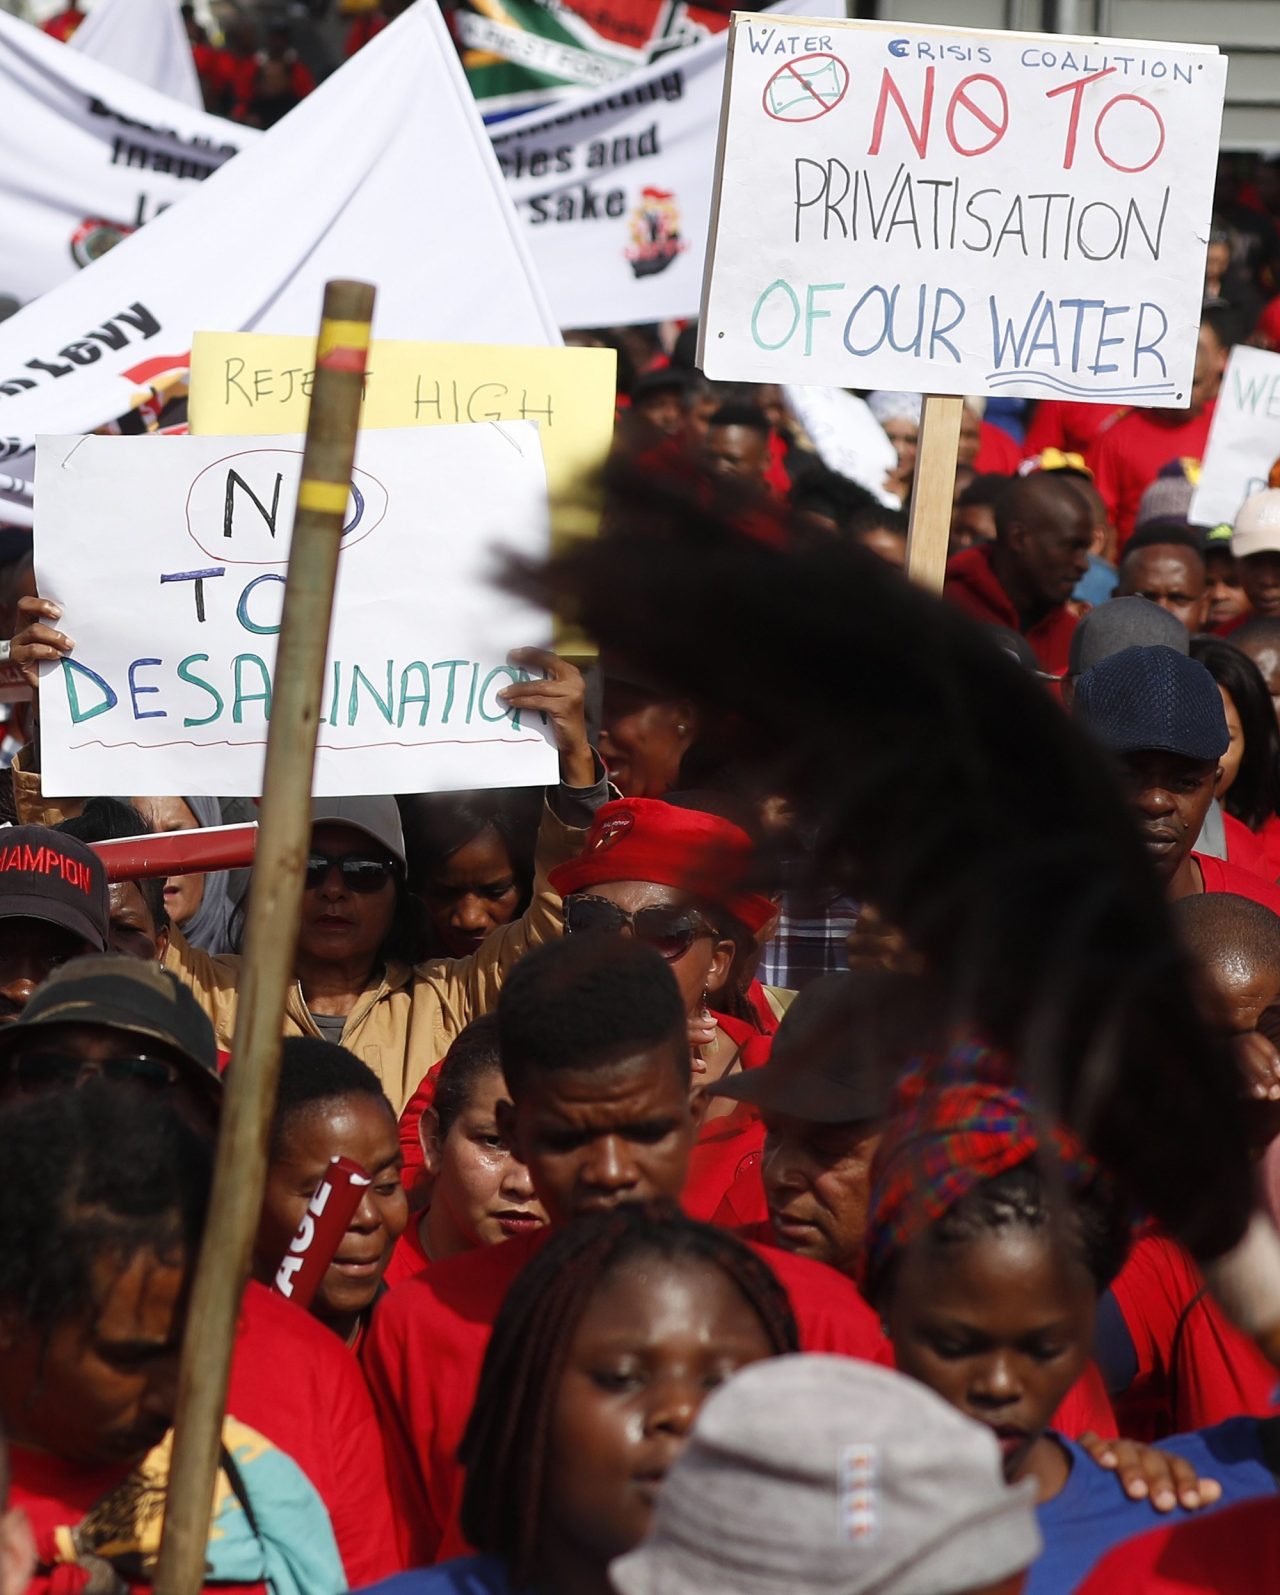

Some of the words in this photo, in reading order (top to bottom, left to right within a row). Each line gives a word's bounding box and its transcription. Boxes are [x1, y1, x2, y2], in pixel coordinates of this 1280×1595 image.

[749, 26, 833, 56] WATER
[1021, 48, 1193, 85] COALITION
[587, 121, 660, 171] and
[867, 65, 1009, 159] NO
[1046, 67, 1165, 173] TO
[528, 183, 625, 225] sake
[795, 158, 1170, 261] PRIVATISATION
[26, 302, 164, 382] Levy
[751, 279, 846, 357] OF
[843, 284, 966, 364] OUR
[989, 290, 1169, 378] WATER
[414, 375, 554, 427] HIGH
[61, 652, 549, 732] DESAINATION
